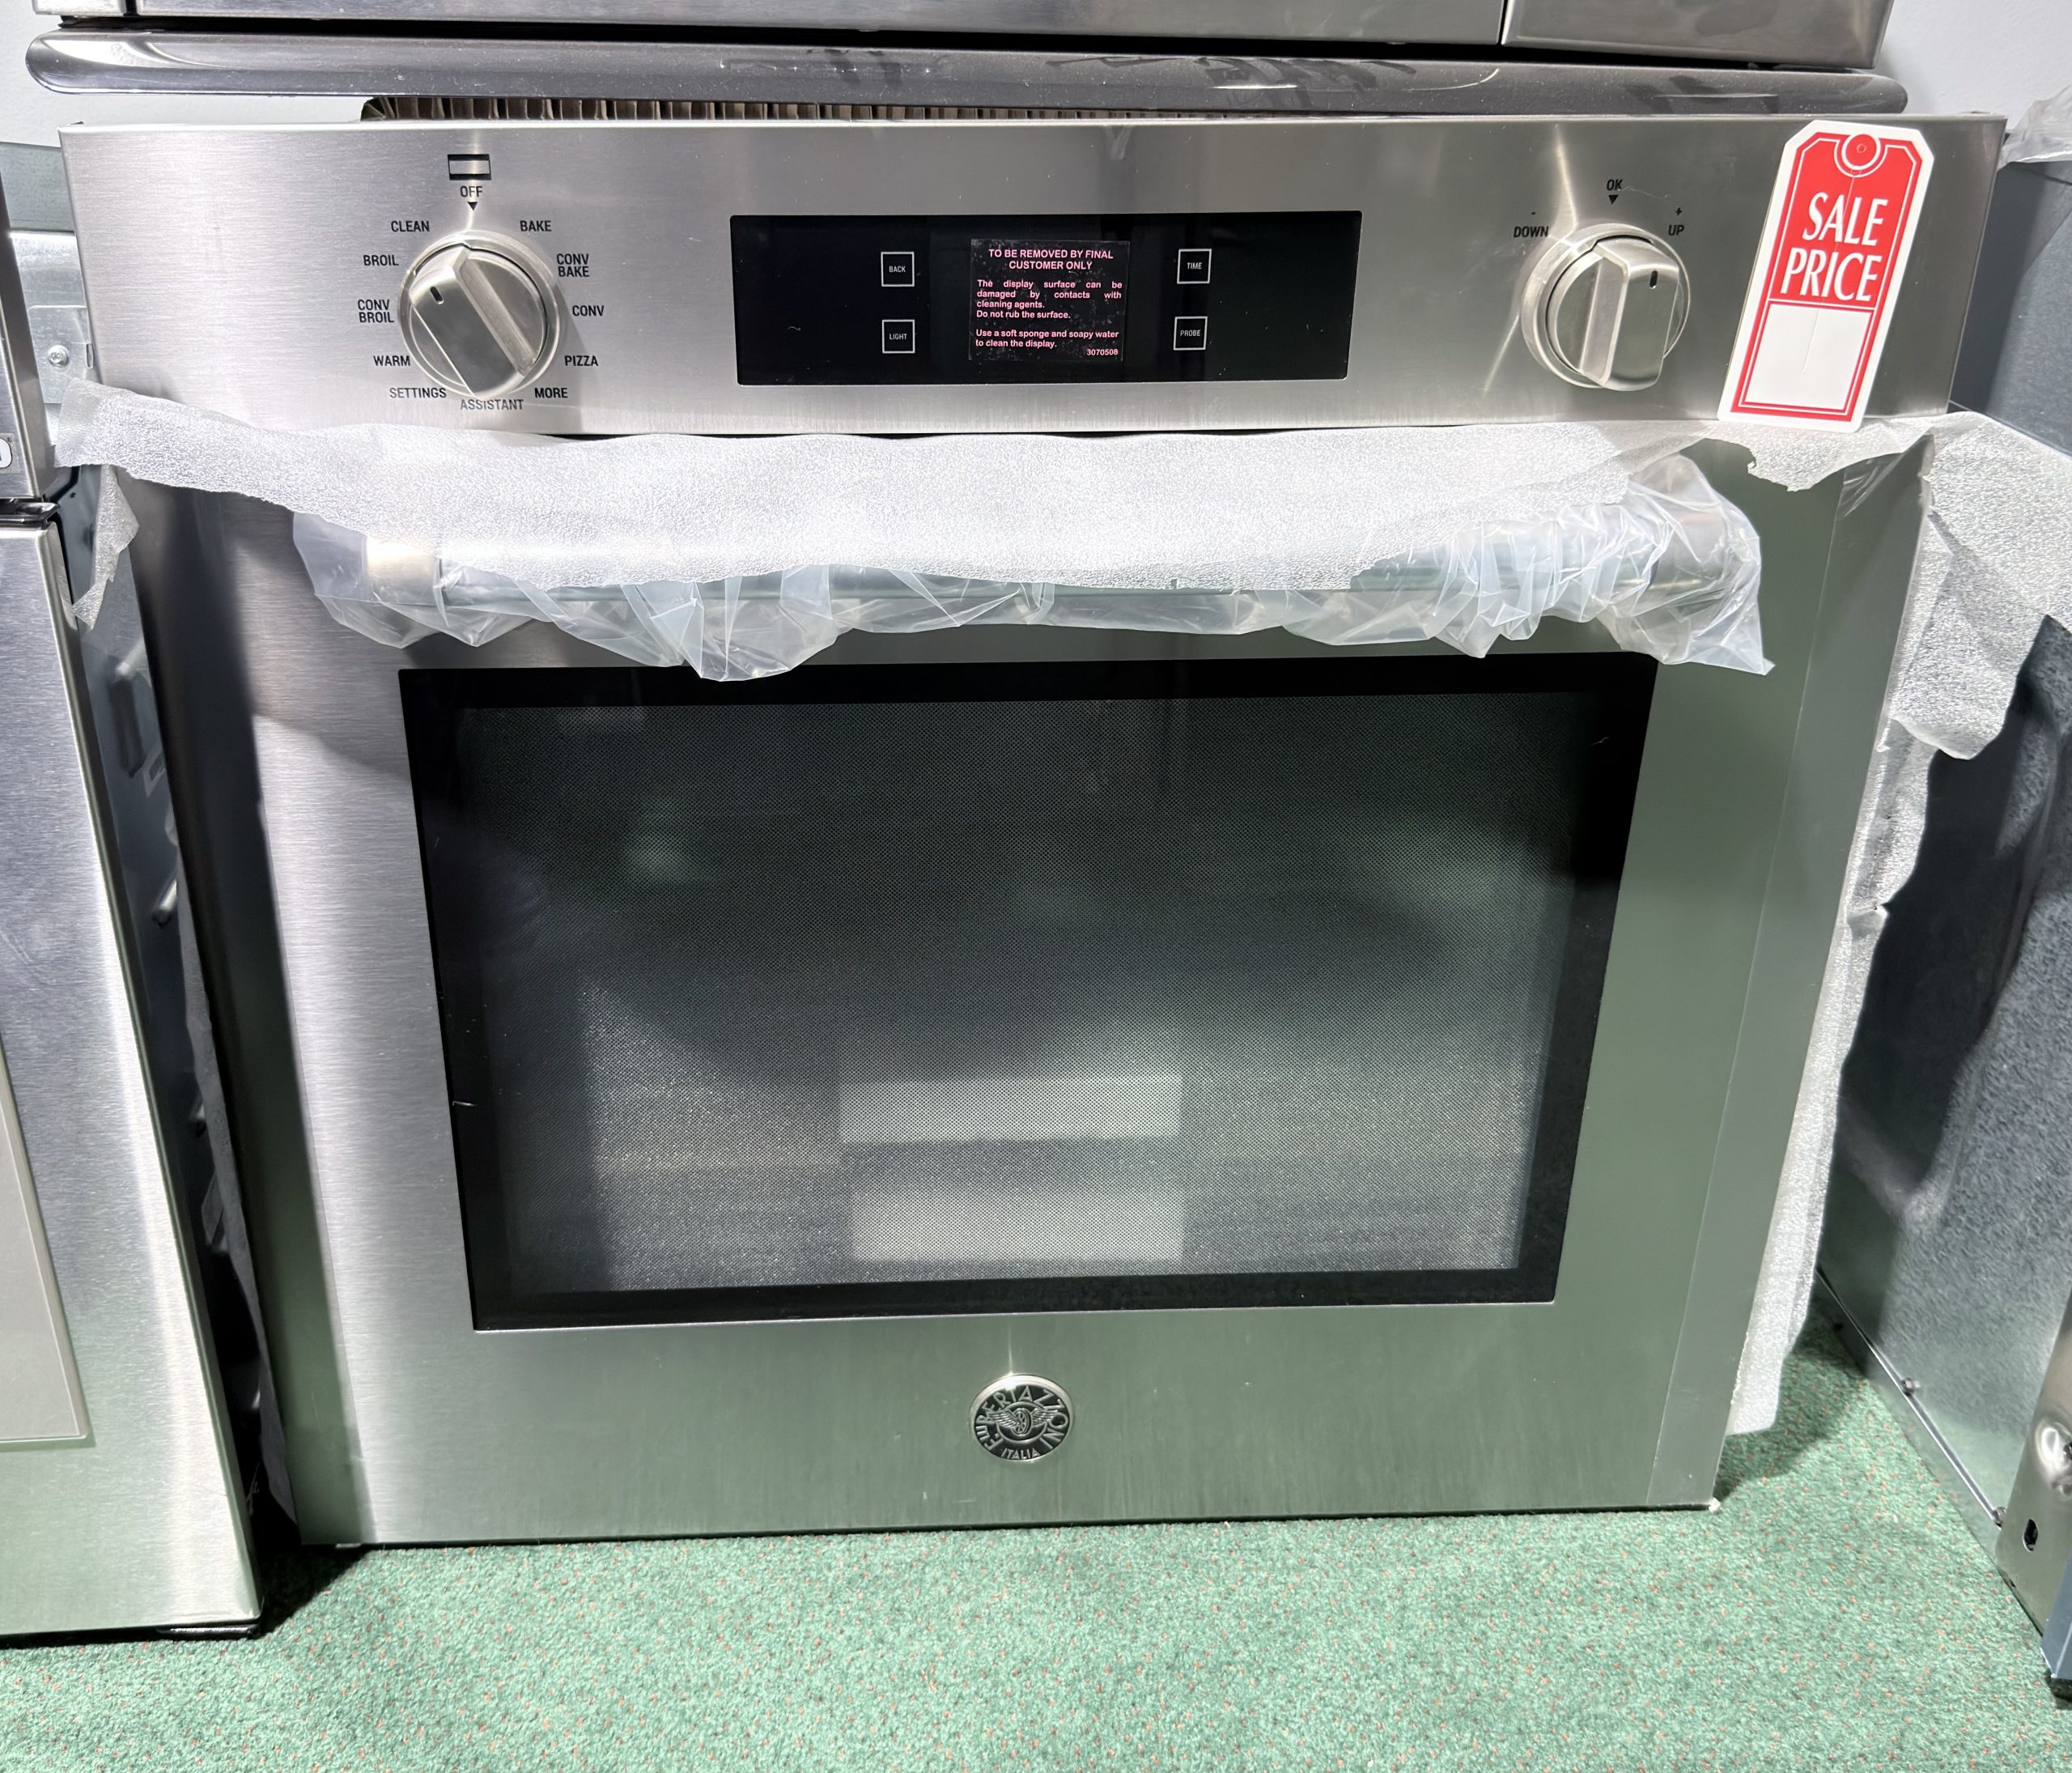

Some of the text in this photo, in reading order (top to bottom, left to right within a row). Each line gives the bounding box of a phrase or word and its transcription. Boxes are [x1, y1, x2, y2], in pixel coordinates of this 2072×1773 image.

[1606, 179, 1623, 191] OK
[460, 185, 483, 198] OFF
[1802, 192, 1888, 246] SALE
[390, 220, 430, 232] CLEAN
[520, 220, 552, 232] BAKE
[1513, 225, 1549, 239] DOWN
[1667, 224, 1685, 237] UP
[556, 253, 589, 266] CONV
[988, 249, 1114, 259] TO BE REMOVED BY FINAL
[363, 255, 399, 266] BROIL
[1008, 261, 1093, 270] CUSTOMER ONLY
[558, 266, 590, 278] BAKE
[1780, 247, 1883, 302] PRICE
[977, 279, 993, 287] The
[1003, 279, 1034, 289] display
[1043, 280, 1076, 288] surface
[1111, 281, 1123, 289] be
[977, 290, 1016, 299] damaged
[1030, 291, 1040, 300] by
[357, 299, 390, 311] CONV
[976, 300, 1045, 309] cleaning agents.
[571, 305, 605, 317] CONV
[976, 310, 988, 318] Do
[1005, 310, 1020, 318] rub
[1037, 311, 1071, 319] surface.
[359, 312, 395, 323] BROIL
[975, 329, 992, 337] Use
[1018, 331, 1049, 339] sponge
[1051, 330, 1067, 338] and
[1068, 331, 1093, 340] soapy
[985, 339, 1008, 347] clean
[1010, 339, 1024, 347] the
[1025, 340, 1057, 349] display.
[373, 355, 411, 367] WARM
[564, 355, 599, 367] PIZZA
[389, 387, 447, 399] SETTINGS
[534, 387, 568, 399] MORE
[460, 399, 524, 411] ASSISTANT
[1001, 1448, 1041, 1460] ITALIA
